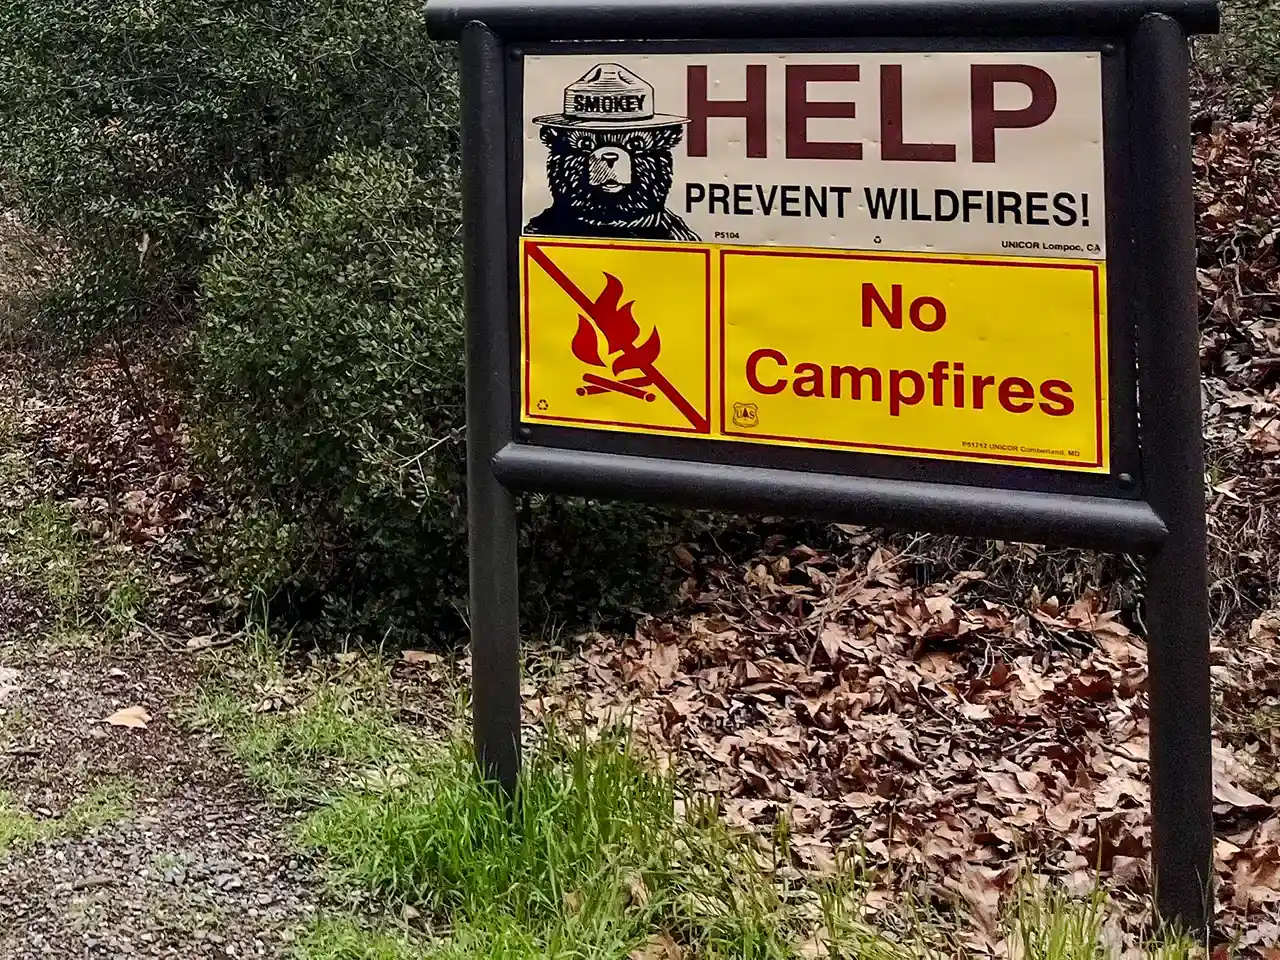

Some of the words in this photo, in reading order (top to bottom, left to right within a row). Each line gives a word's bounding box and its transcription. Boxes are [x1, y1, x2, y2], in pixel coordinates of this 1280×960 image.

[573, 94, 646, 113] SMOKEY
[685, 63, 1058, 163] HELP
[685, 183, 852, 219] PREVENT
[863, 186, 1091, 227] WILDFIRES!
[714, 231, 740, 239] P5104
[1001, 240, 1040, 249] UNICOR
[1086, 243, 1101, 252] CA
[860, 283, 947, 332] No
[745, 348, 1075, 417] Campfires
[989, 444, 1019, 452] UNICOR
